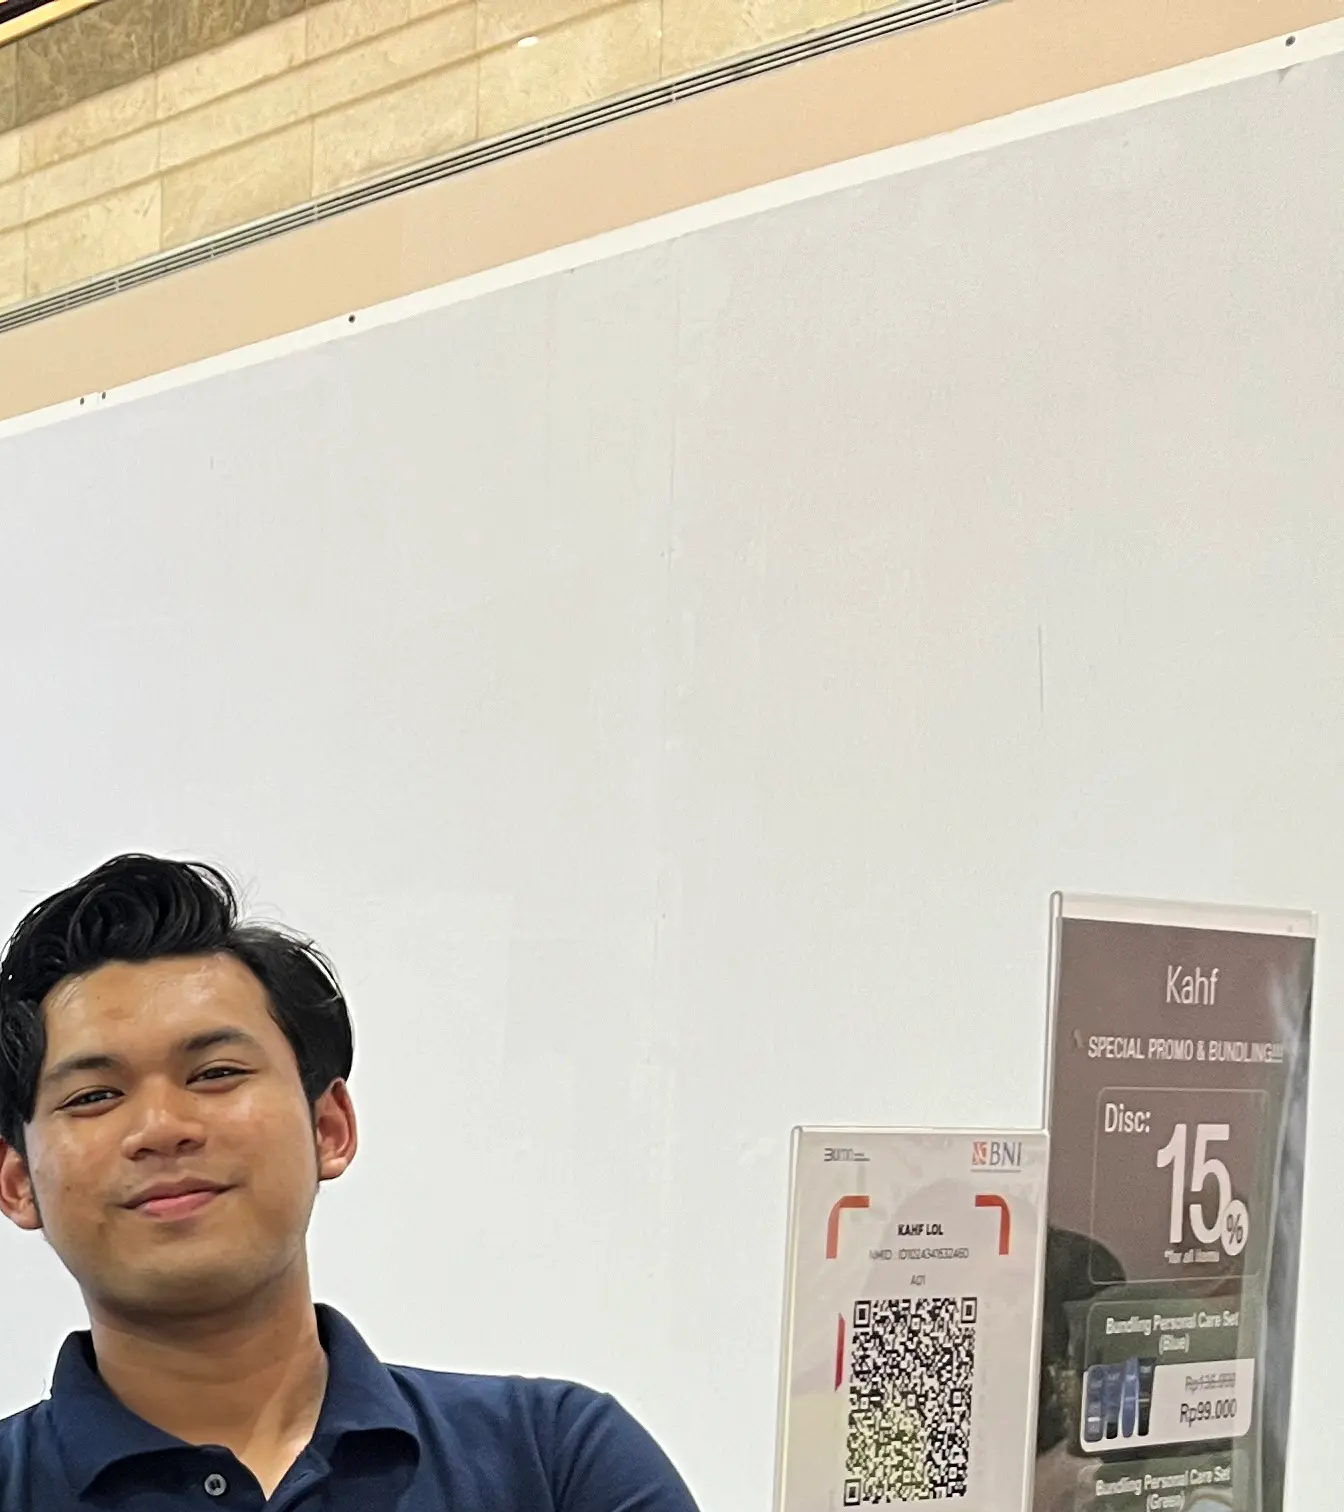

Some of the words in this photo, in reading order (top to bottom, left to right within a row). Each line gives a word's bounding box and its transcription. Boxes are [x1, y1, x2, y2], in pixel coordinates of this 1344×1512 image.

[1166, 964, 1219, 1005] Kahf
[1088, 1036, 1145, 1059] SPECIAL
[1148, 1039, 1193, 1060] PROMO
[1196, 1041, 1206, 1061] &
[1104, 1103, 1151, 1133] Disc:
[989, 1142, 1022, 1166] BNI
[898, 1224, 923, 1236] KAHF
[926, 1224, 944, 1235] LOL
[1106, 1316, 1151, 1335] Bundling
[1153, 1312, 1196, 1331] Personal
[1198, 1313, 1221, 1328] Care
[1222, 1311, 1239, 1326] Set
[1159, 1333, 1190, 1355] (Blue)
[1180, 1399, 1237, 1426] Rp99.000
[1096, 1478, 1142, 1496] Bundling
[1144, 1471, 1188, 1490] Personal
[1190, 1468, 1212, 1484] Care
[1214, 1466, 1232, 1482] Set
